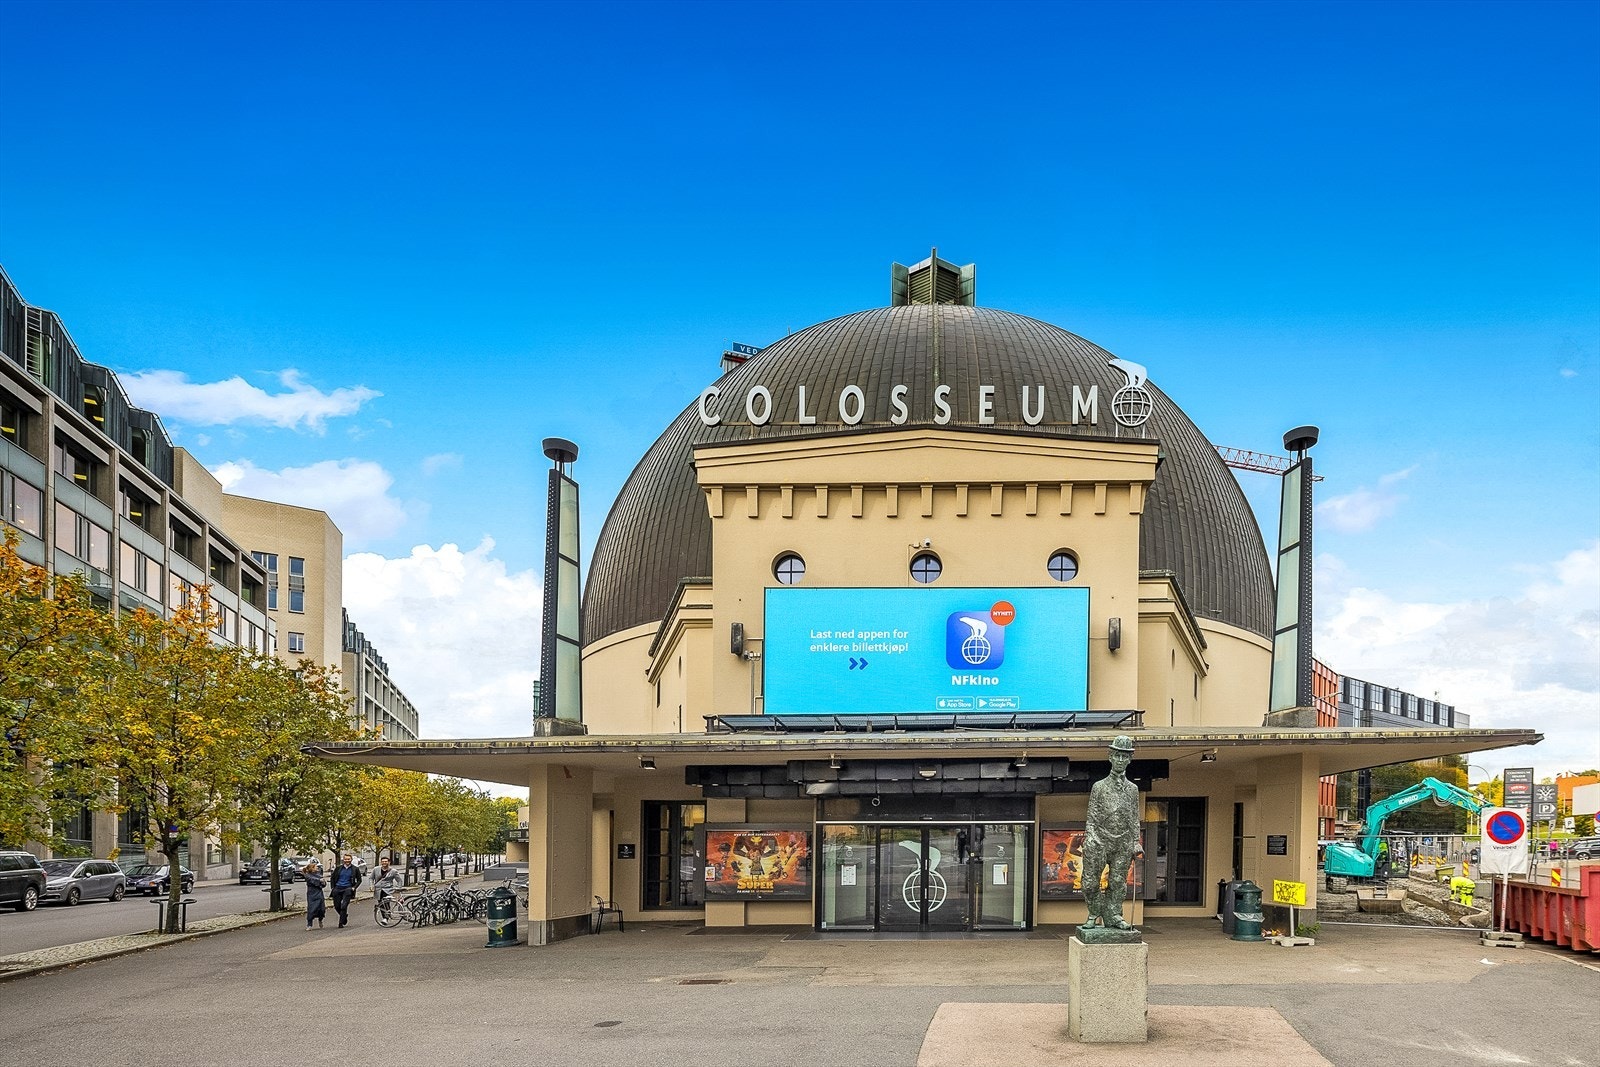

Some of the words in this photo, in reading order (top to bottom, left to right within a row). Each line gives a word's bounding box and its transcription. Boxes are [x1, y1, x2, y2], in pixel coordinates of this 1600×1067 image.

[699, 384, 1098, 426] COLOSSEUM
[810, 629, 832, 639] Last
[835, 629, 855, 639] ned
[857, 630, 890, 641] appen
[893, 629, 909, 639] for
[810, 642, 850, 652] enklere
[852, 642, 909, 654] billettkjøp!
[951, 674, 1000, 686] NFkino
[737, 878, 774, 890] SUPER
